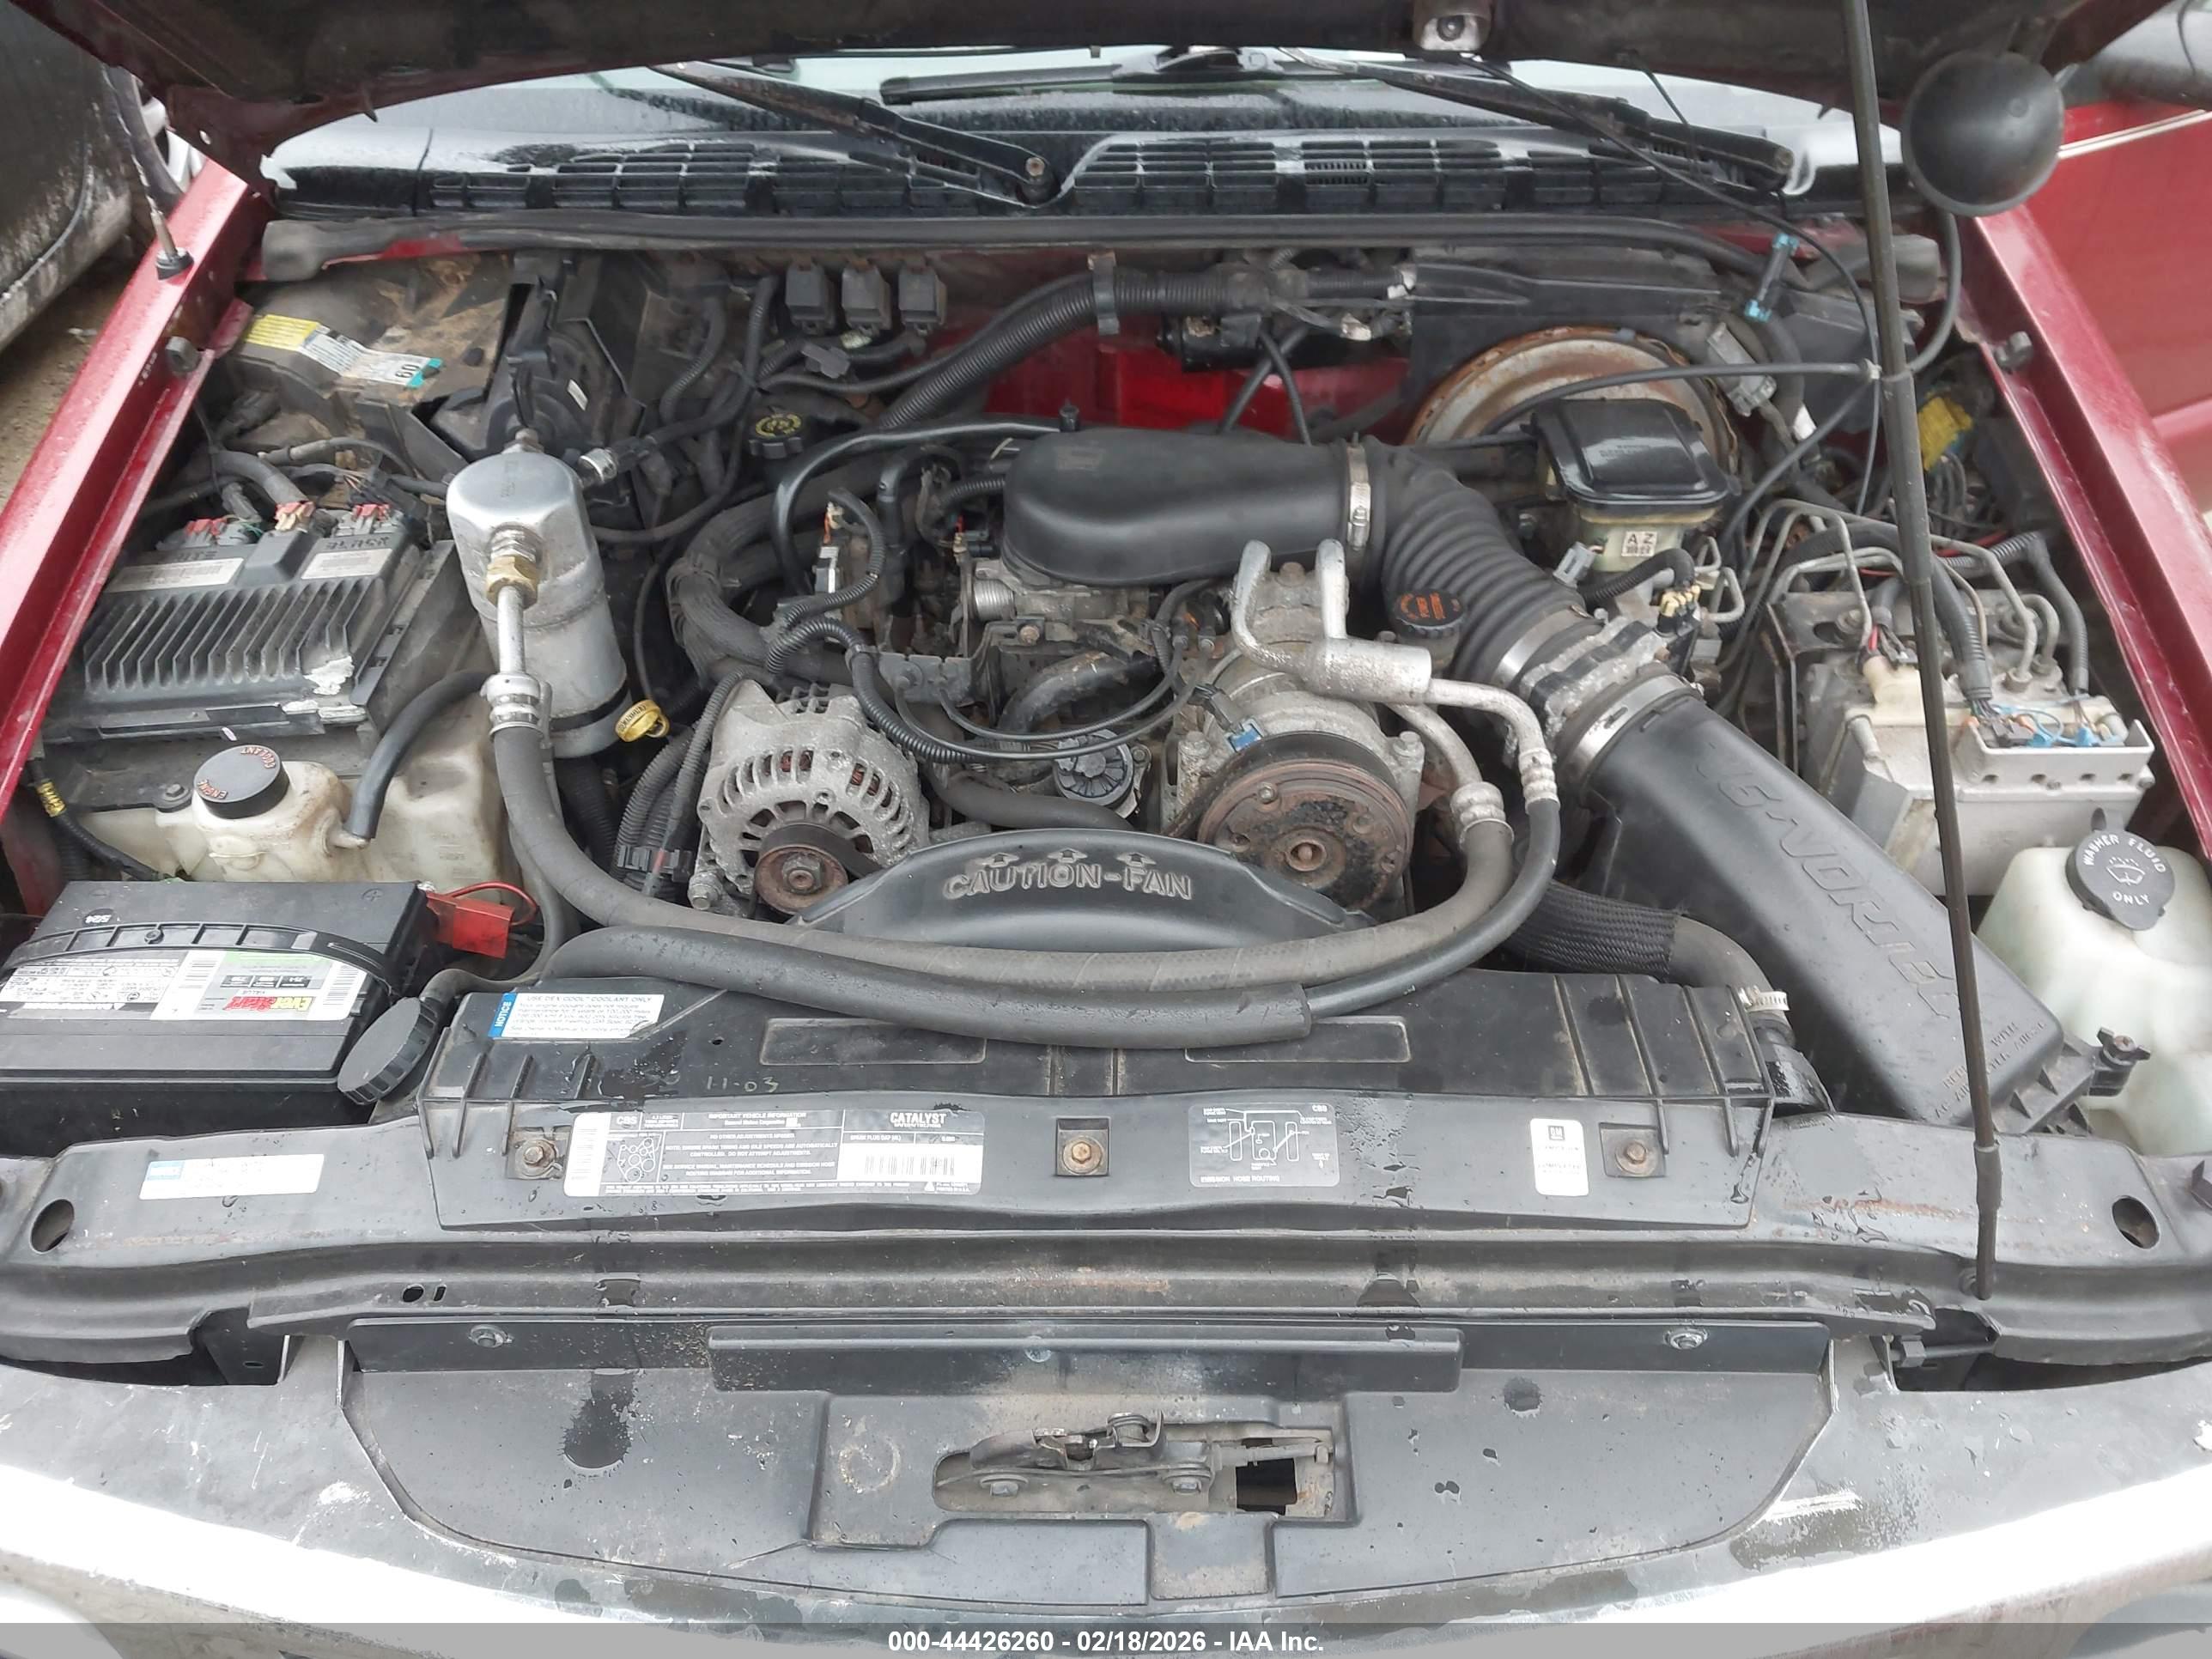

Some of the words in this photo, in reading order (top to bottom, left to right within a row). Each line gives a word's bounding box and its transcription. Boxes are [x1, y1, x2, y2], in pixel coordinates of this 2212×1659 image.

[2082, 834, 2120, 866] WASHER
[2129, 837, 2166, 872] FLUID
[2112, 890, 2150, 905] ONLY
[495, 1001, 512, 1027] NOTICE
[890, 1113, 946, 1124] CATALYST
